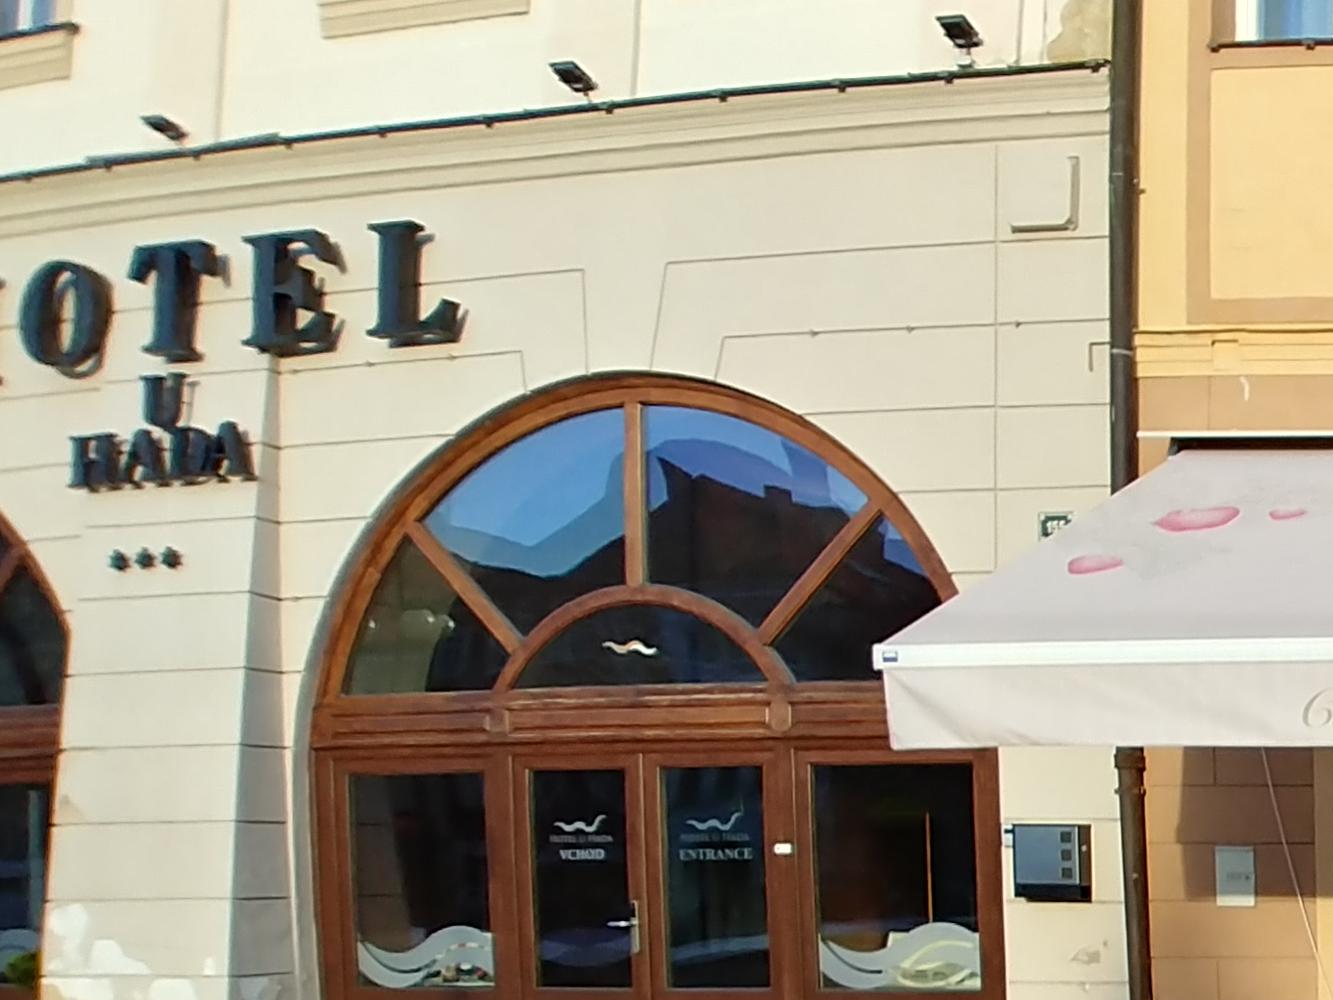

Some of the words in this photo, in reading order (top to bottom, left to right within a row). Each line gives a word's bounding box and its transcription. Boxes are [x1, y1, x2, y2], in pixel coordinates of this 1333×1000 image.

[0, 219, 464, 379] OTEL
[139, 371, 193, 432] U
[67, 421, 259, 491] HADA
[559, 848, 606, 861] VCHOD
[679, 847, 754, 861] ENTRANCE
